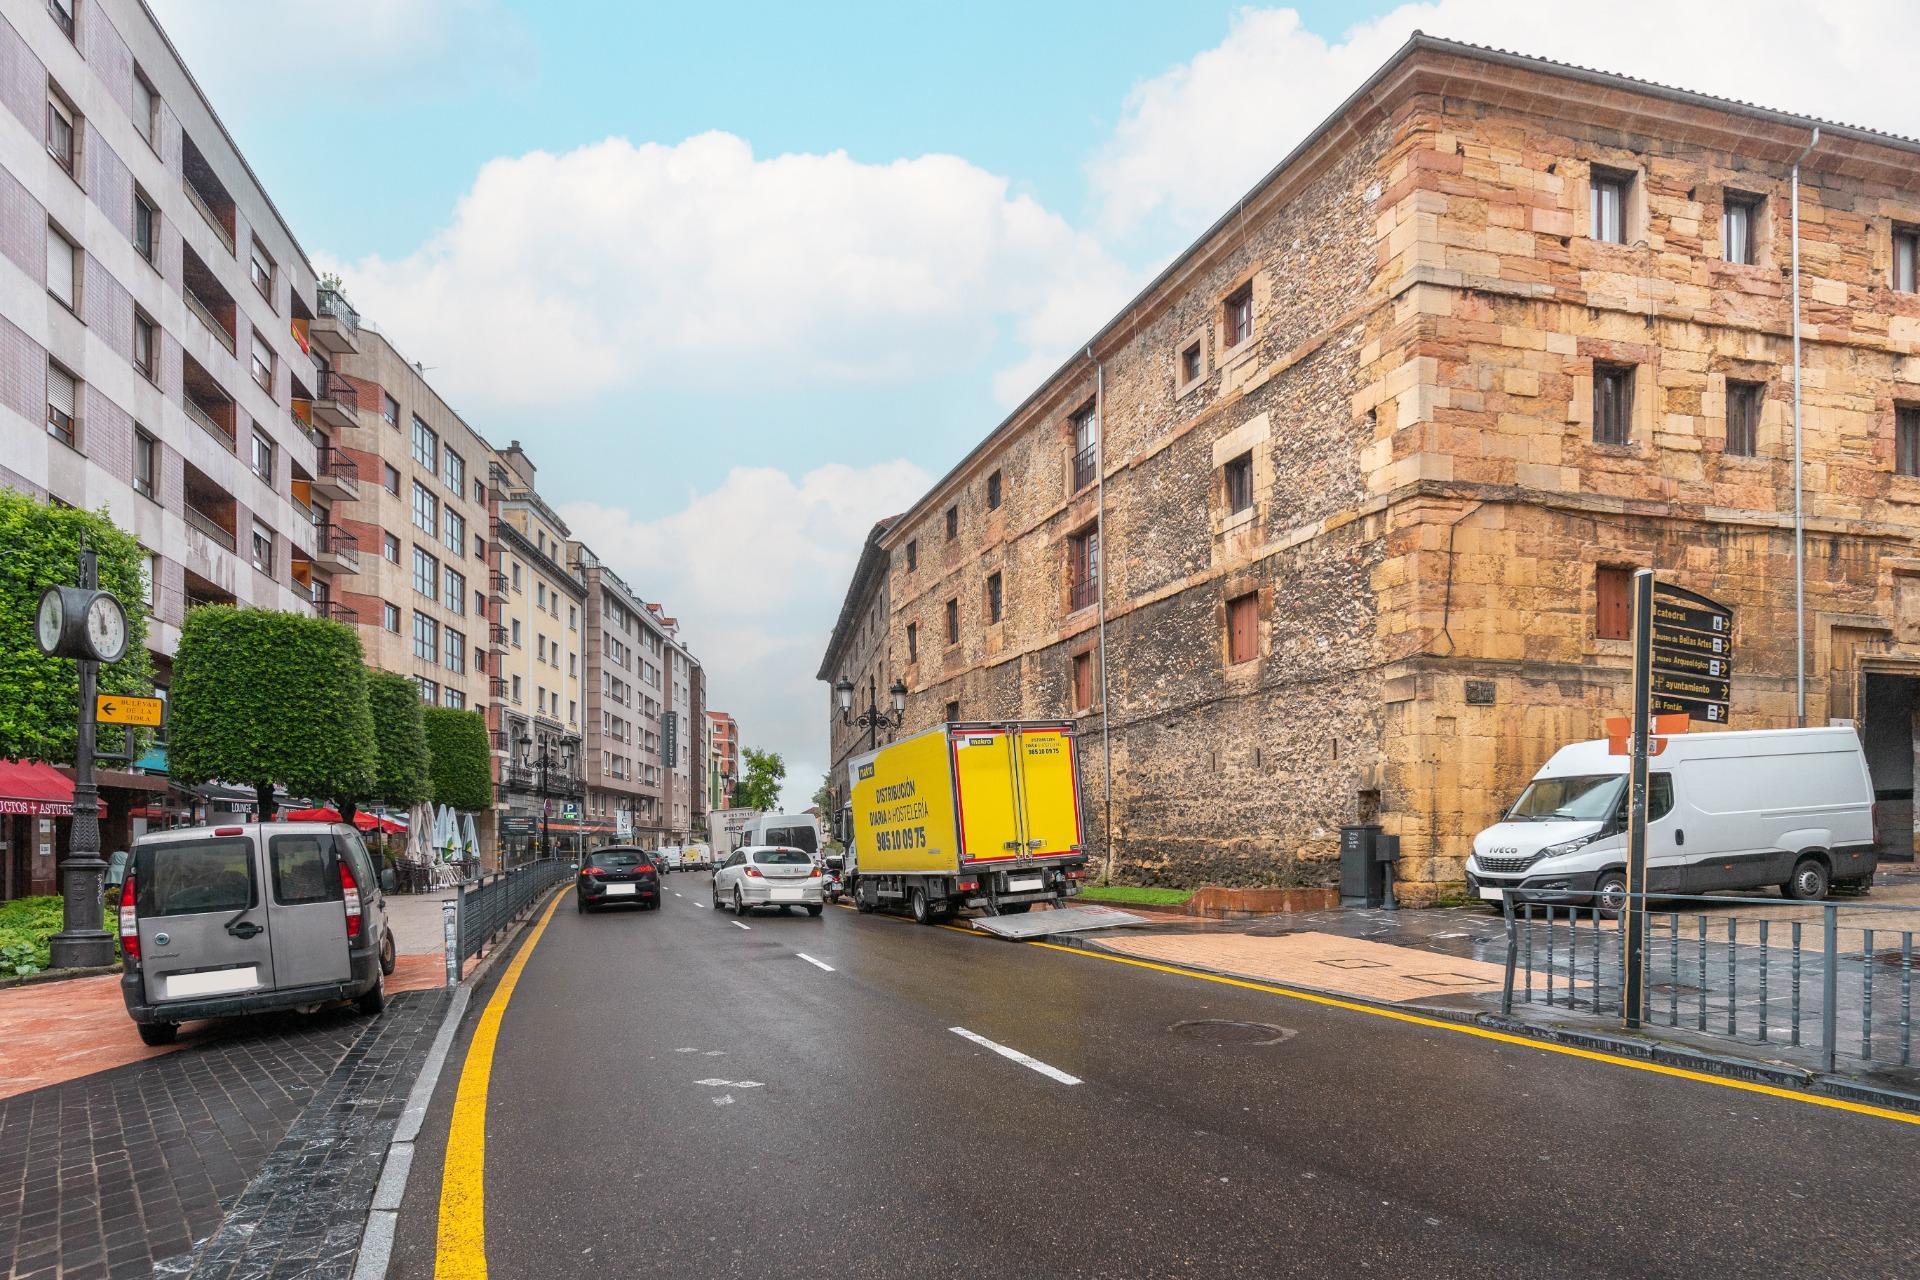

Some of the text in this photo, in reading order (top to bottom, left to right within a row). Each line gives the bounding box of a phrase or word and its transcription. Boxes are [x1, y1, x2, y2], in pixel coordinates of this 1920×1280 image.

[1657, 609, 1686, 621] catedral
[1679, 634, 1696, 645] Bellas
[1697, 638, 1712, 648] Artes
[1673, 656, 1708, 669] Arqueológico
[1665, 680, 1710, 693] ayuntamiento
[1663, 702, 1683, 711] Fontán
[971, 738, 992, 746] makro
[876, 776, 916, 804] DISTRIBUCIÓN
[231, 802, 252, 813] LOUNGE
[869, 809, 887, 826] DIARIA
[893, 797, 928, 822] HOSTELERÍA
[877, 826, 926, 852] 985 10 09 75
